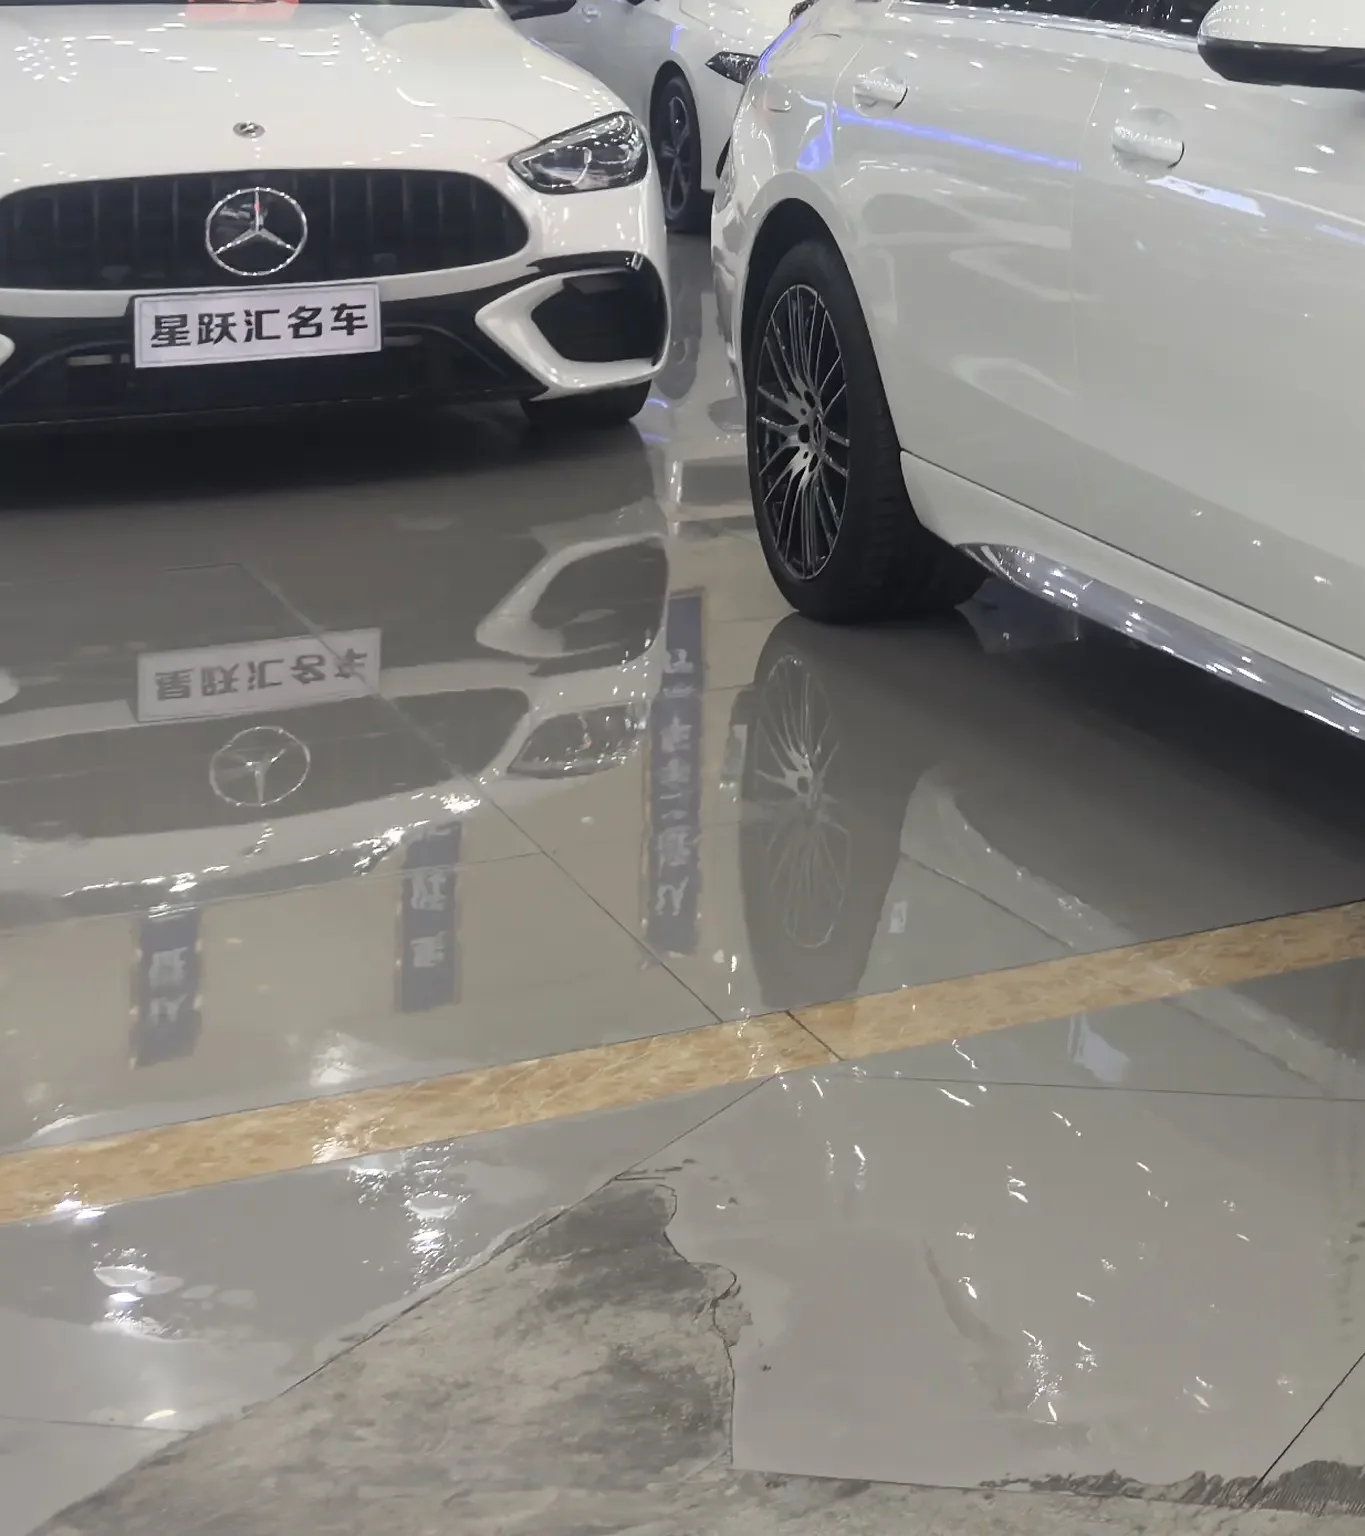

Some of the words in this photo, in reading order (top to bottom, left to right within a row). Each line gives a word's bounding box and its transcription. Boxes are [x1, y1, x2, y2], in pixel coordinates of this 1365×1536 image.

[151, 303, 369, 348] 星跃汇名车
